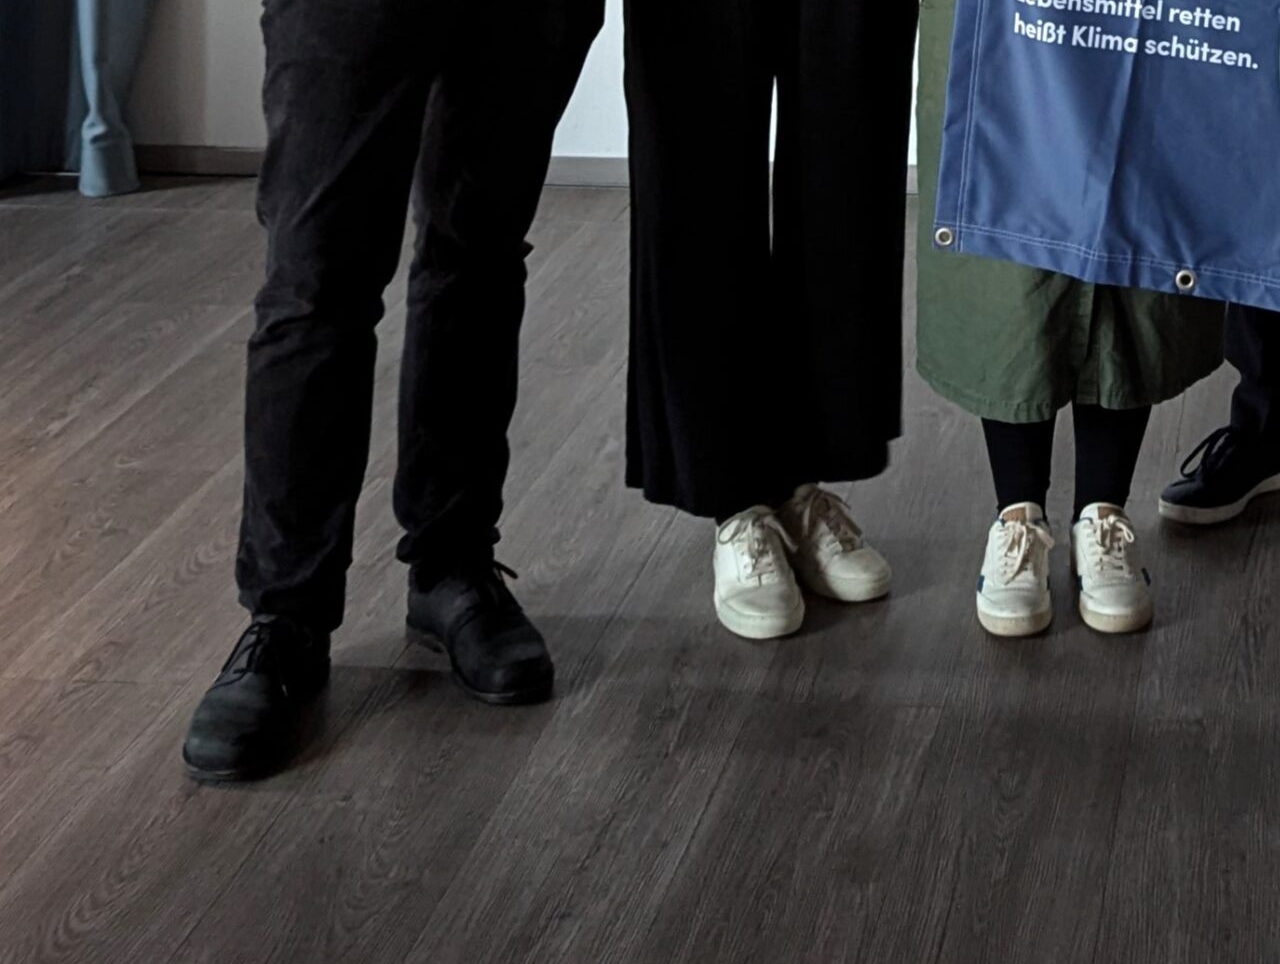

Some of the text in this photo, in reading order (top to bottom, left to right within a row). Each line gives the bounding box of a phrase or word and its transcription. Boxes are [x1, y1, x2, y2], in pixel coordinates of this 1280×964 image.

[1168, 6, 1241, 32] retten
[1013, 12, 1259, 69] heißt Klima schützen.
